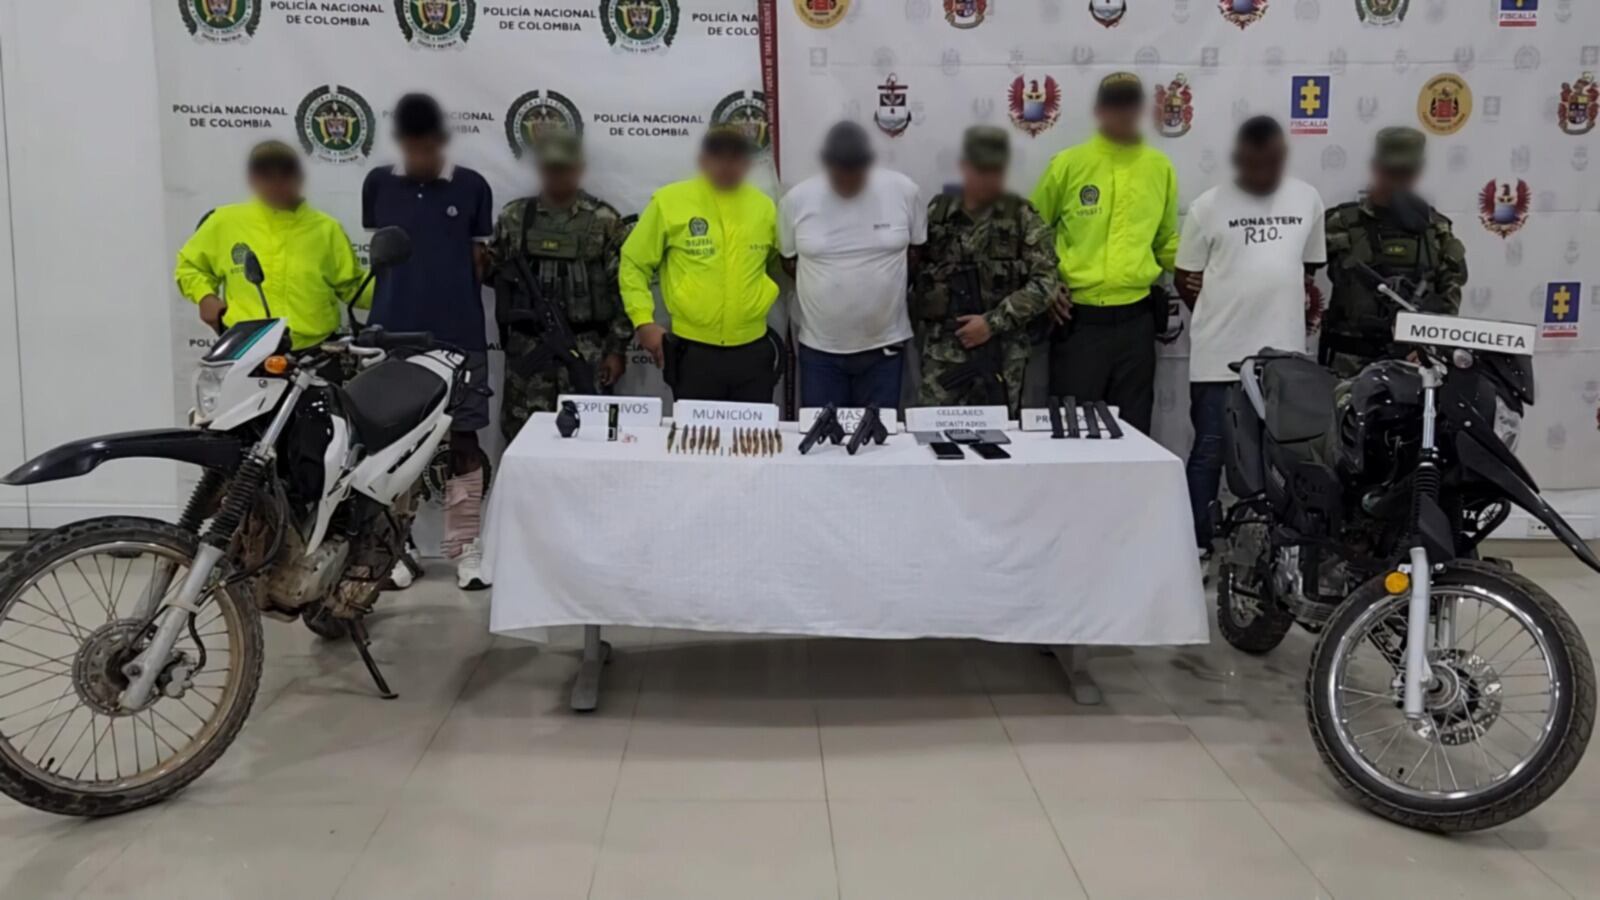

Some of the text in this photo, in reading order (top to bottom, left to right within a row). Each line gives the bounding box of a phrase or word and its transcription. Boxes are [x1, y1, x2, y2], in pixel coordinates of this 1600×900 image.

[271, 0, 384, 13] POLICÍA NACIONAL
[483, 5, 596, 18] POLICÍA NACIONAL
[286, 15, 370, 26] DE COLOMBIA
[692, 12, 738, 22] POLICÍA
[499, 21, 581, 31] DE COLOMBIA
[707, 27, 759, 36] DE COLO
[173, 103, 288, 116] POLICÍA NACIONAL
[190, 118, 272, 128] DE COLOMBIA
[594, 112, 704, 124] POLICÍA NACIONAL
[609, 127, 689, 137] DE COLOMBIA
[1229, 216, 1303, 228] MONASTERY
[1410, 324, 1526, 348] MOTOCICLETA
[692, 408, 763, 421] MUNICIÓN
